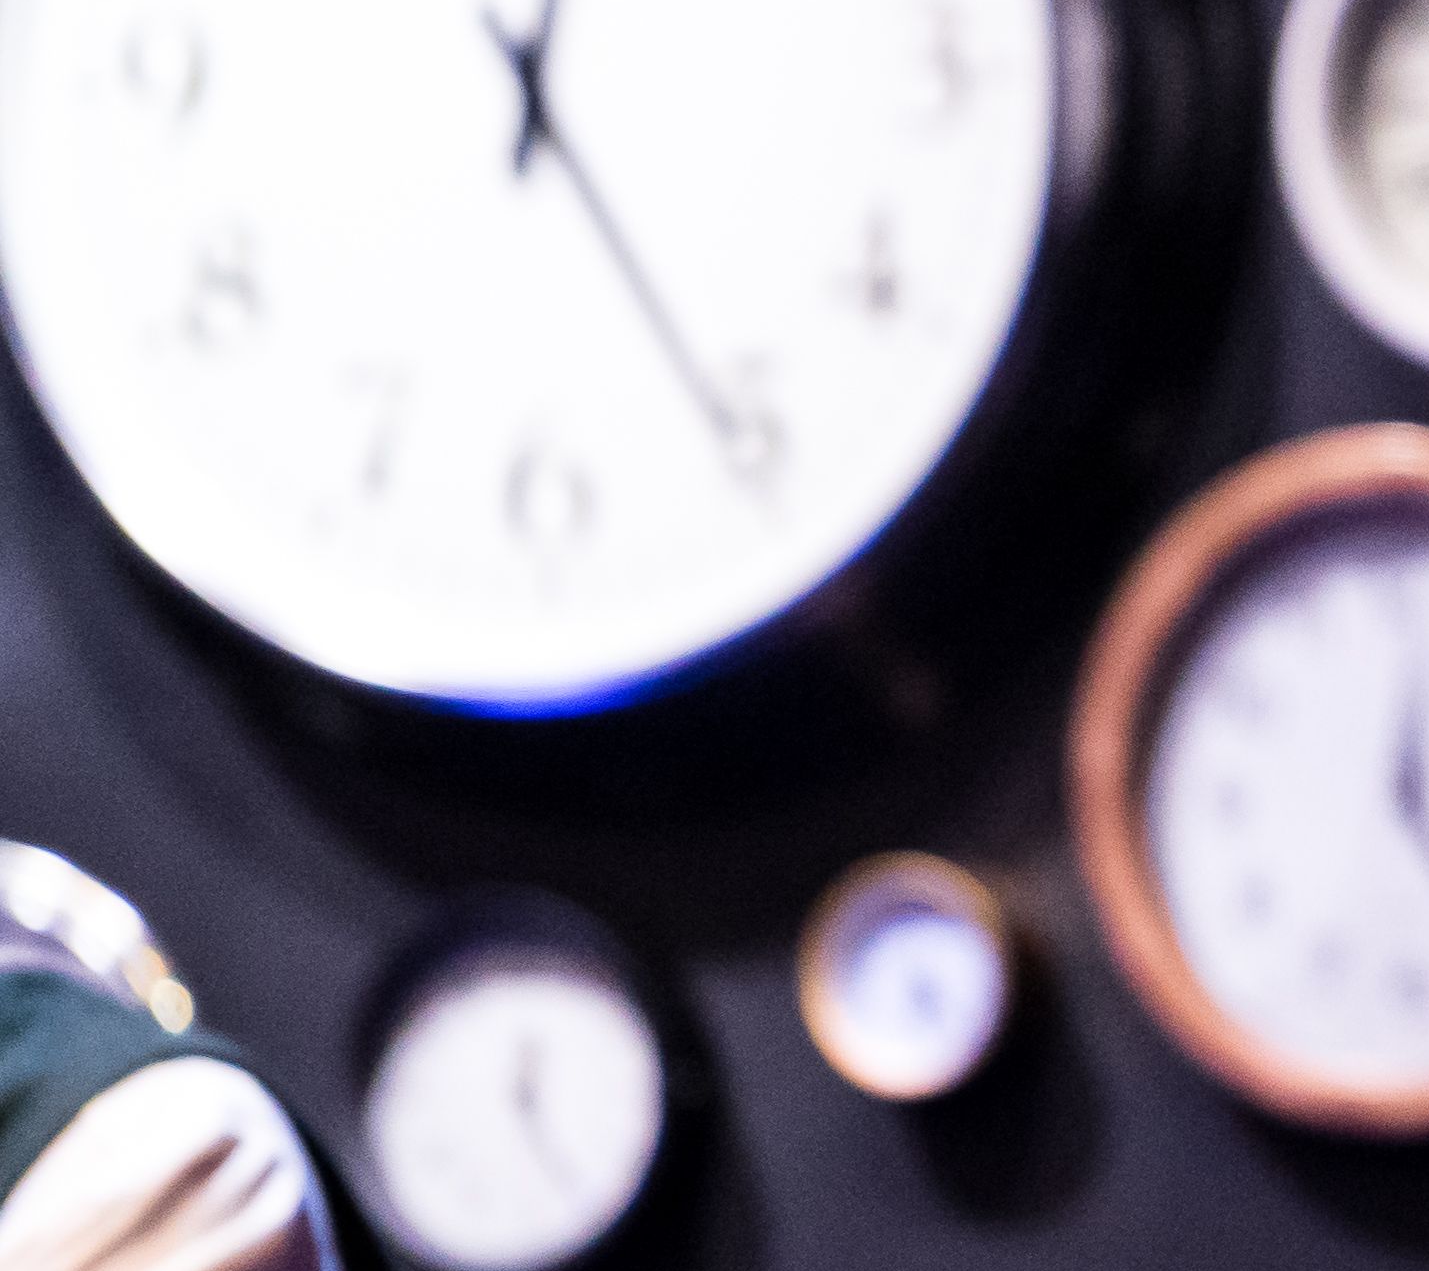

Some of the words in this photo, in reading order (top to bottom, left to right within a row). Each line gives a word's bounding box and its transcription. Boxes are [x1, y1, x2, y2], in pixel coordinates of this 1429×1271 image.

[119, 15, 213, 134] 9
[178, 215, 272, 360] 8
[337, 355, 419, 506] 7
[498, 414, 606, 551] 6
